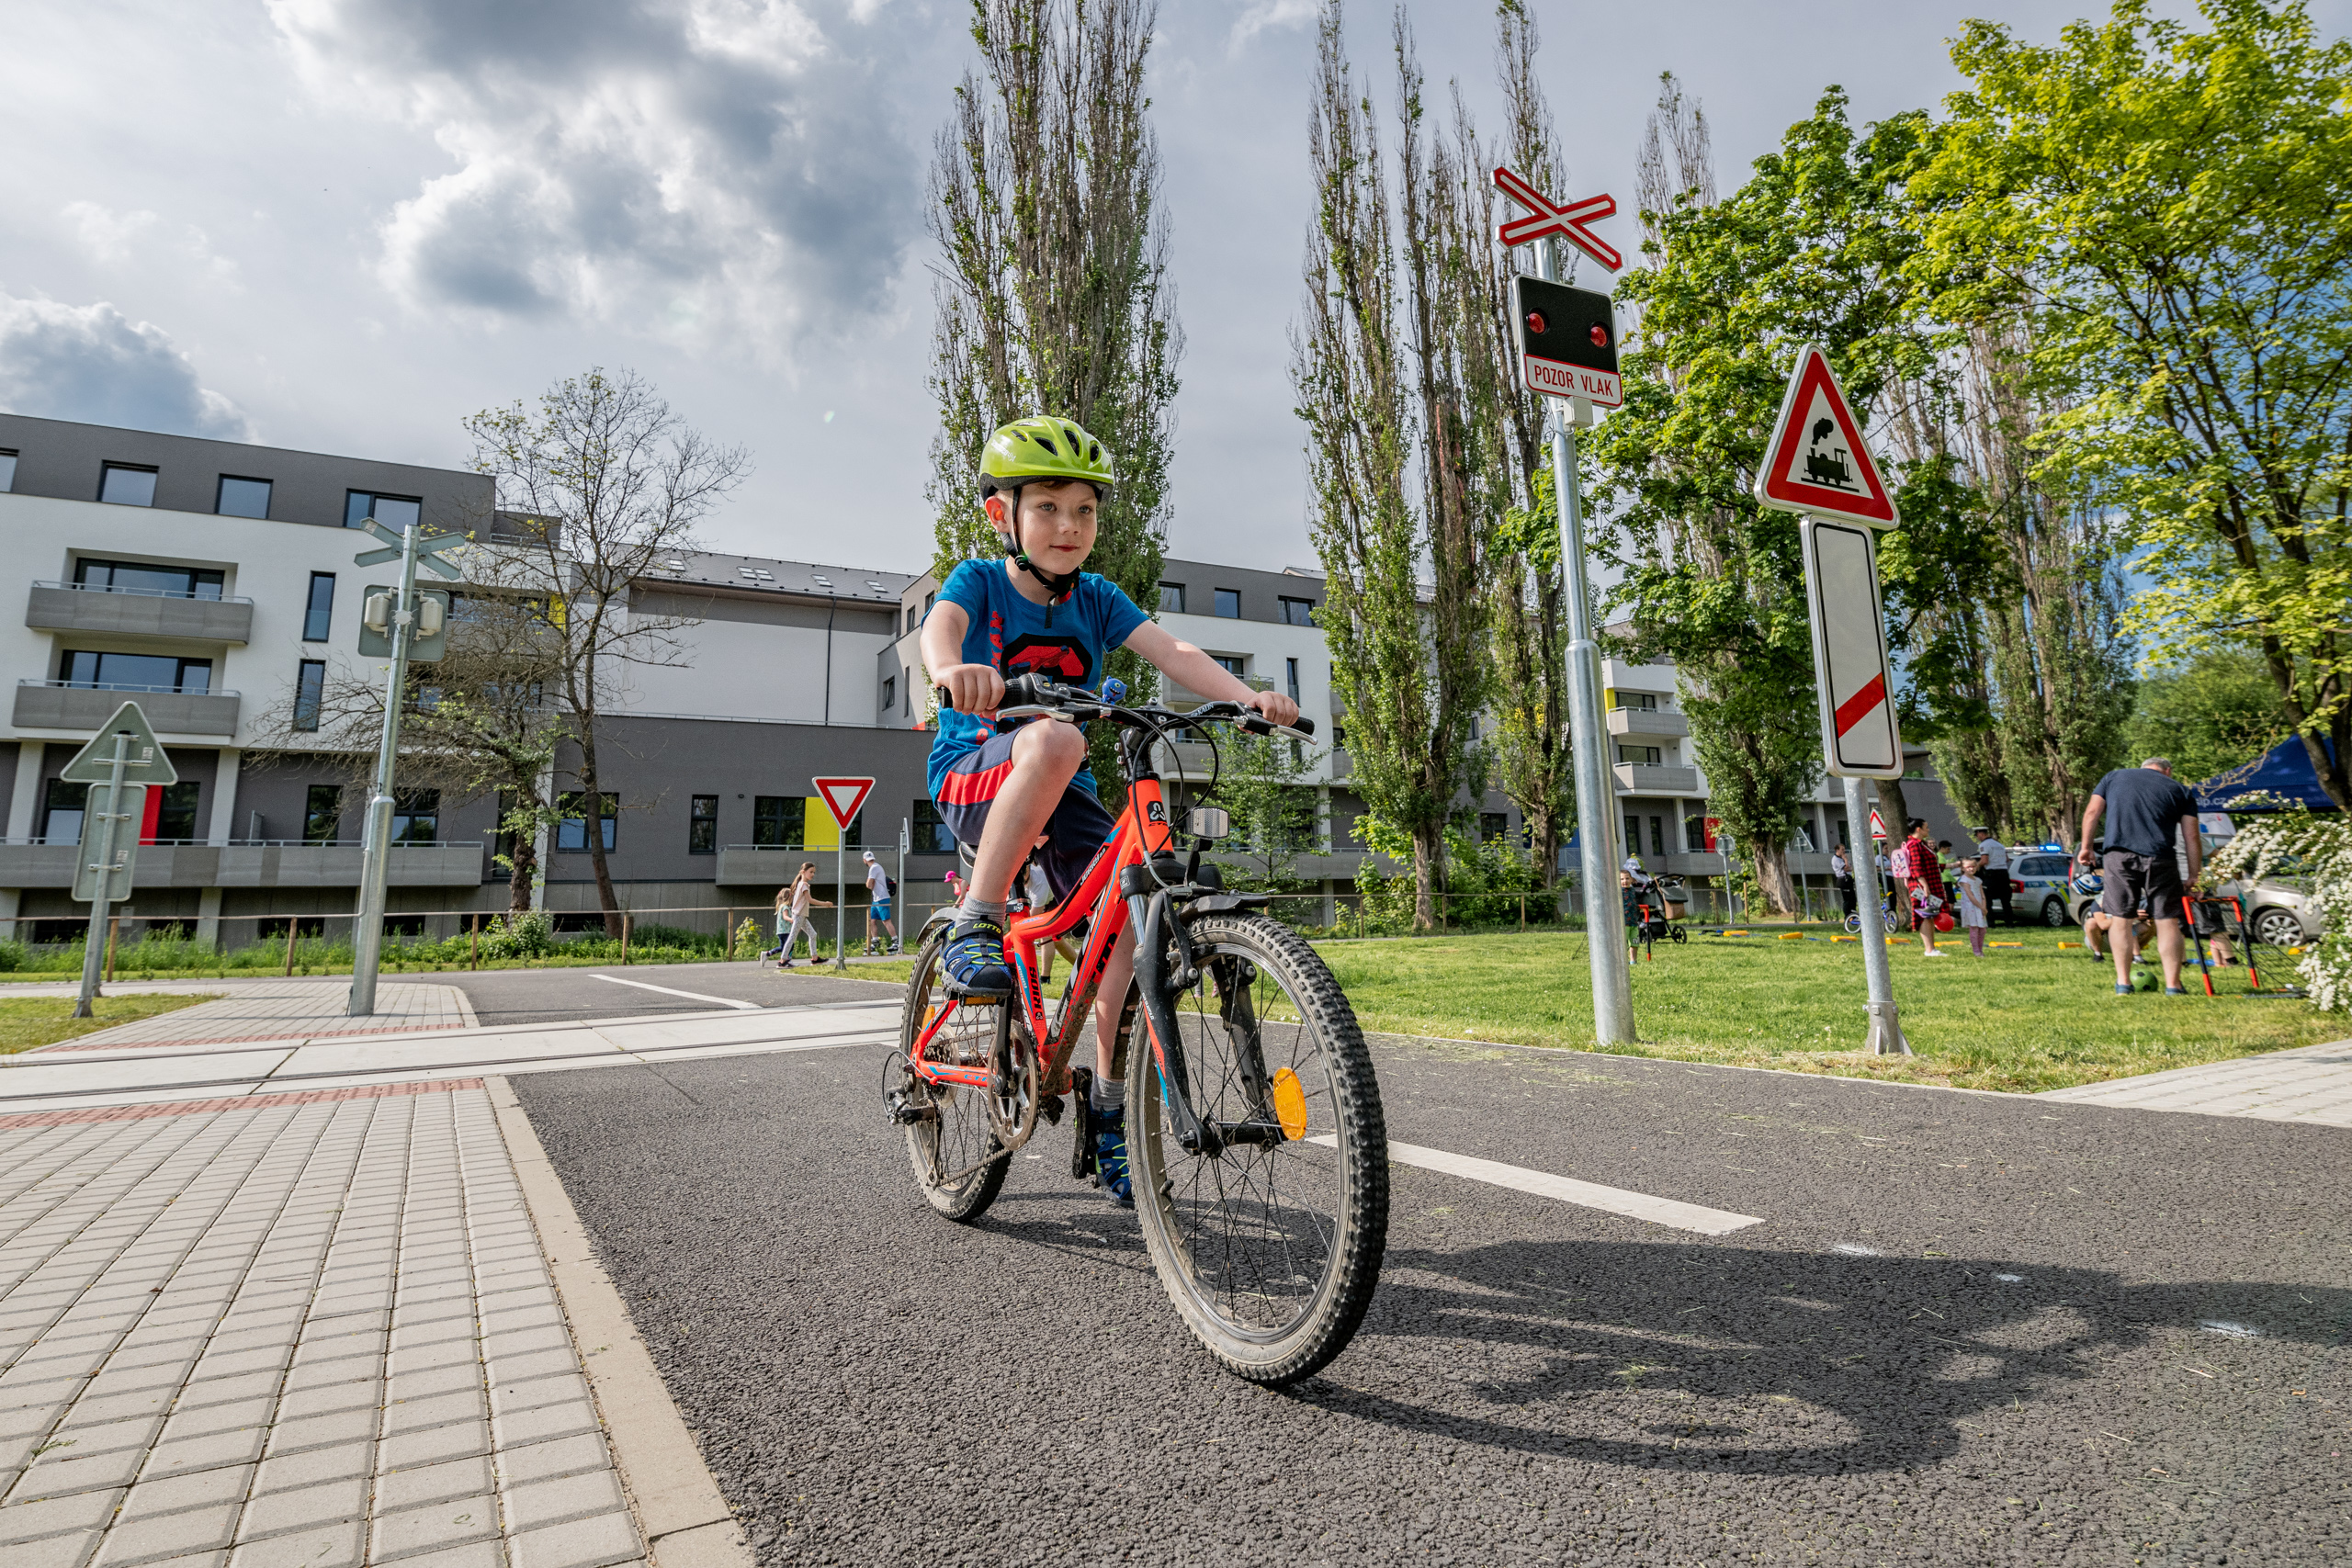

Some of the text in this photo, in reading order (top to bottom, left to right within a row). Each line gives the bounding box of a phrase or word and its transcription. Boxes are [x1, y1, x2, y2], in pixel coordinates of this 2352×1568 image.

[1534, 365, 1613, 397] POZOR VLAK
[973, 922, 1001, 934] LOTTO
